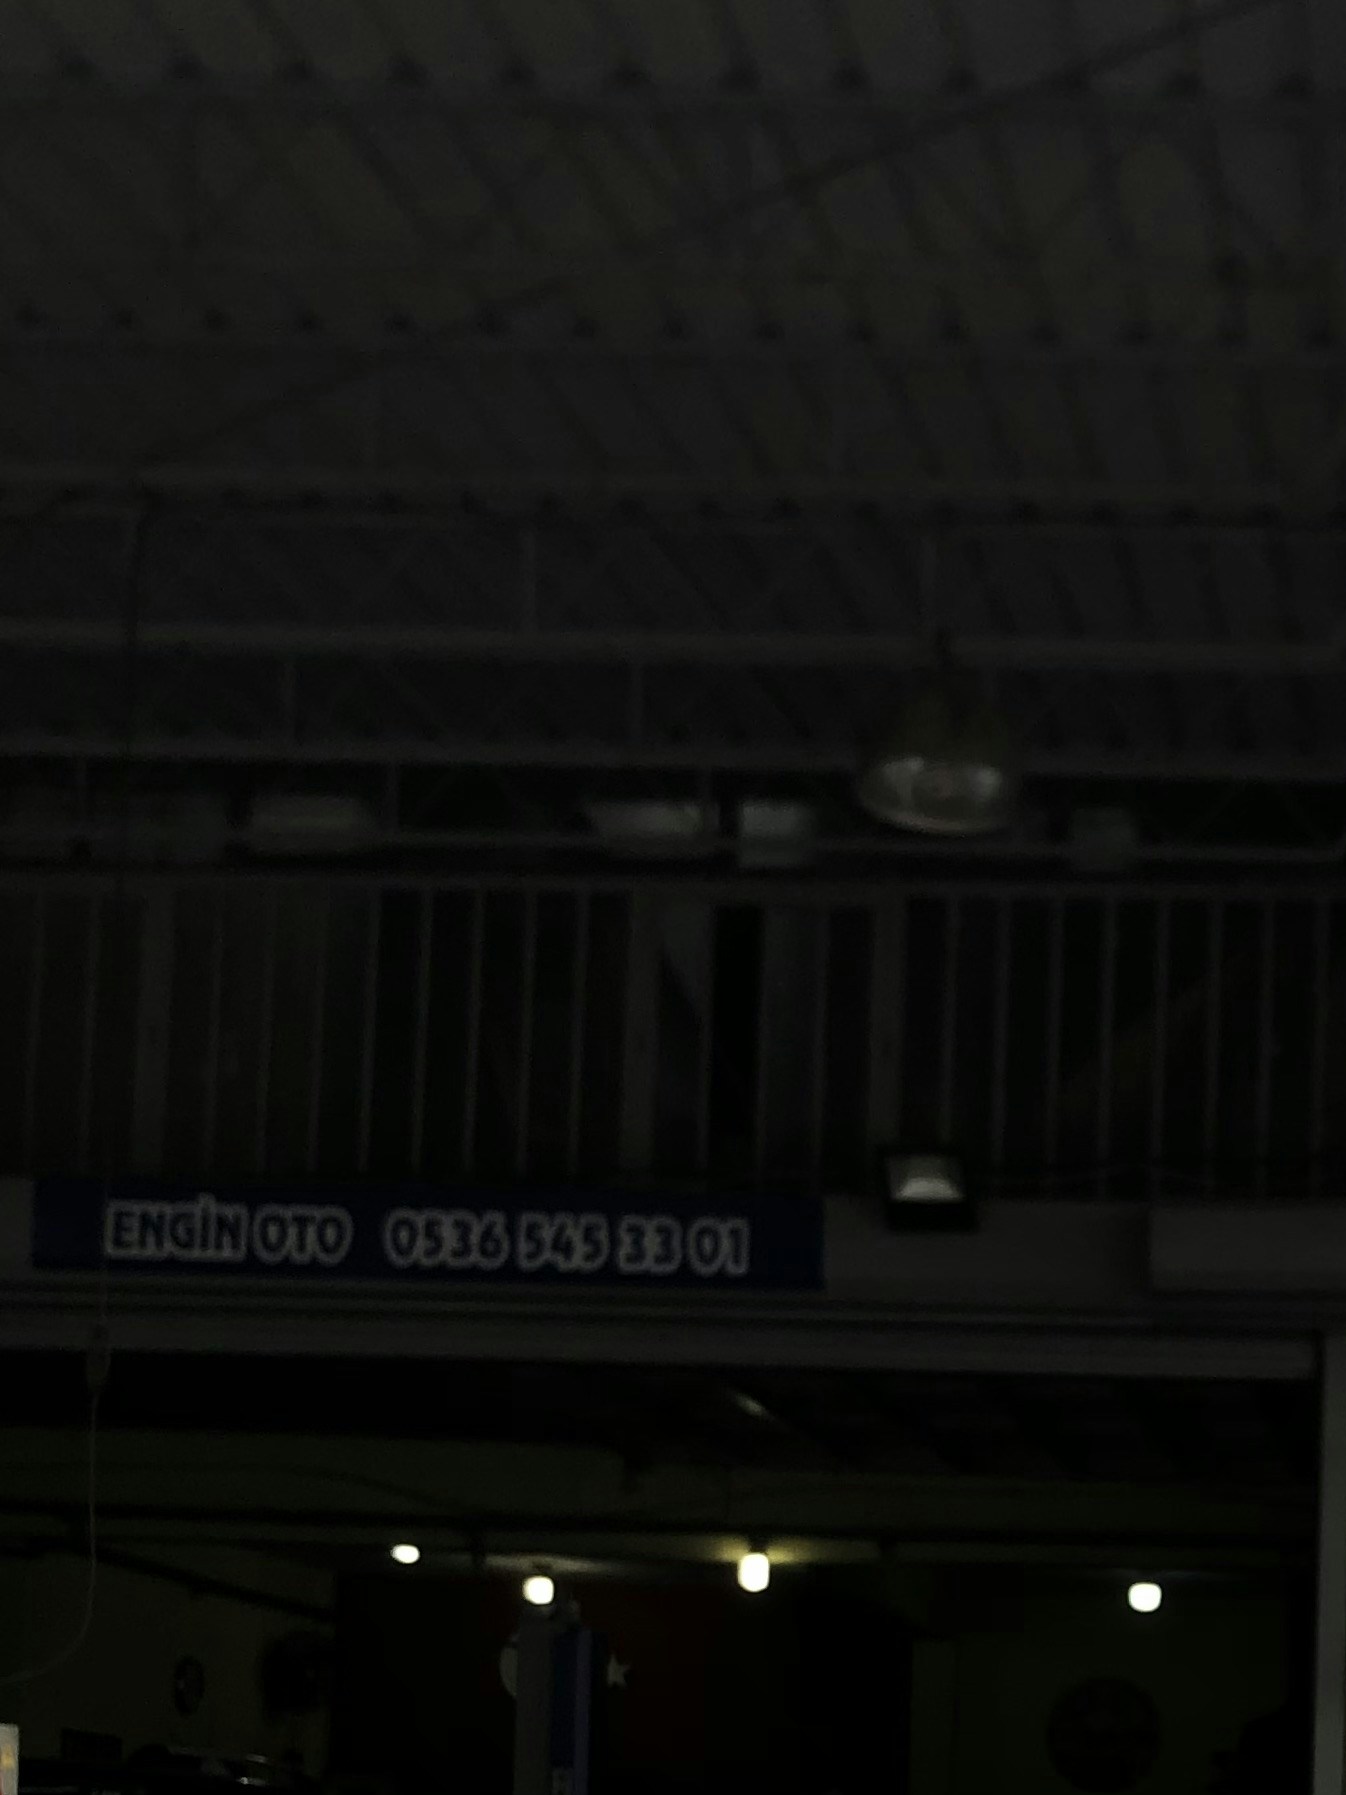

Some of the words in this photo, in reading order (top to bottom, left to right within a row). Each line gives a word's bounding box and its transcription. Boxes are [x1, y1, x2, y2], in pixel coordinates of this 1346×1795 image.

[108, 1194, 247, 1258] ENGİN
[254, 1206, 349, 1262] OTO
[389, 1211, 509, 1267] 0536
[517, 1214, 606, 1273] 545
[619, 1218, 681, 1274] 33
[690, 1219, 749, 1275] 01
